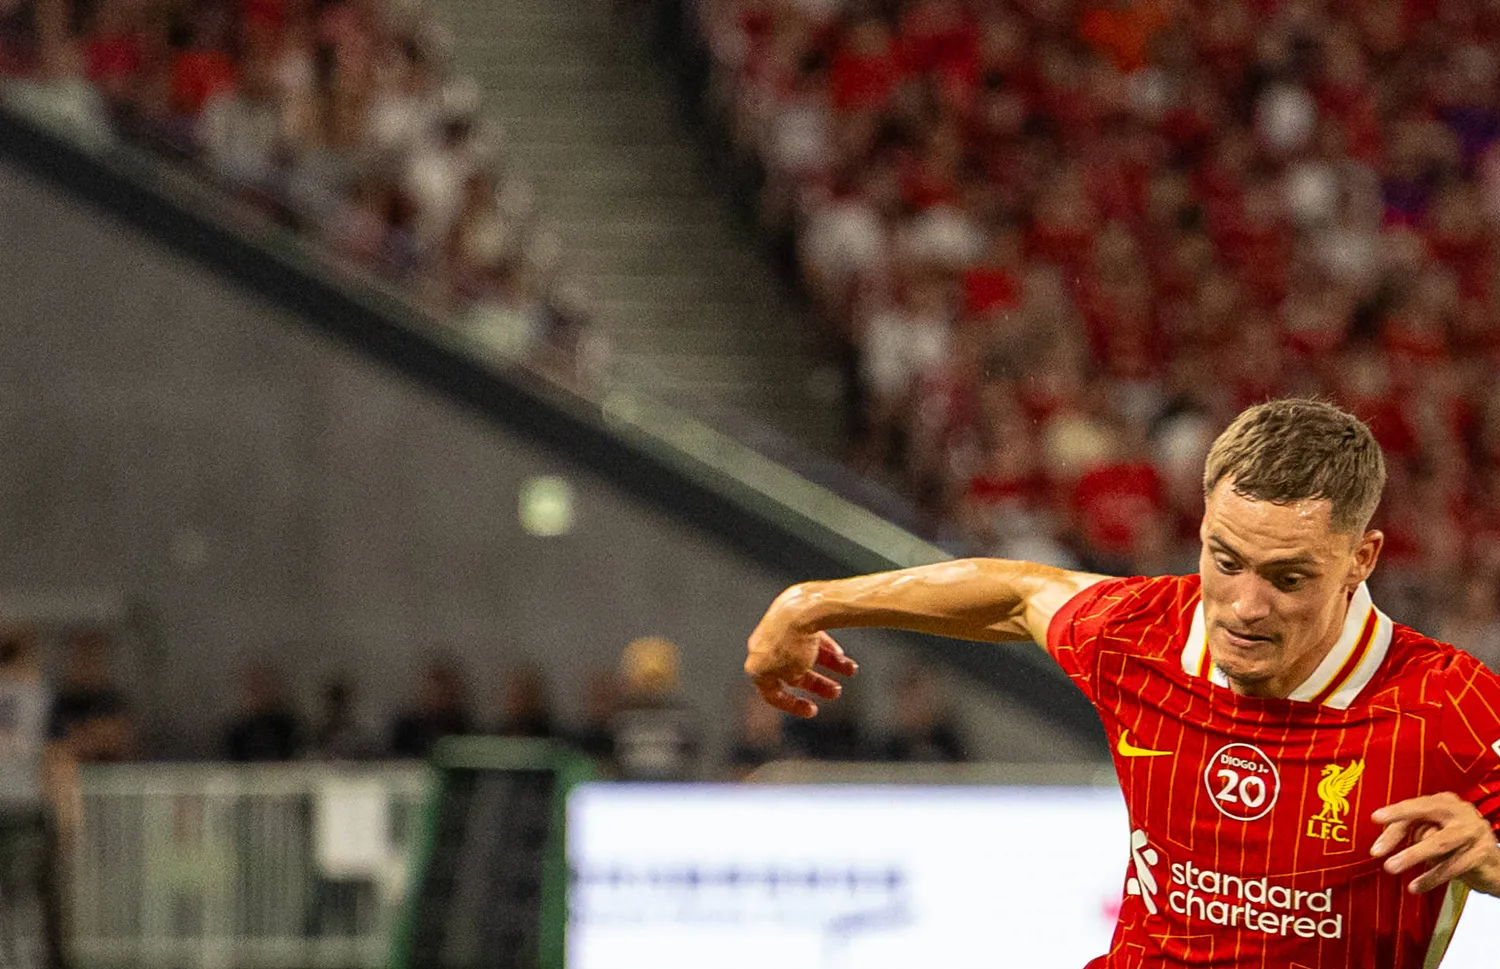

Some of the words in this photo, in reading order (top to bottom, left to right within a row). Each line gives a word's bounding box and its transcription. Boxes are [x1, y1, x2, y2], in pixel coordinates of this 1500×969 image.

[1220, 753, 1257, 771] DIOGO
[1215, 768, 1266, 808] 20
[1171, 860, 1333, 912] standard
[1169, 889, 1343, 939] chartered
